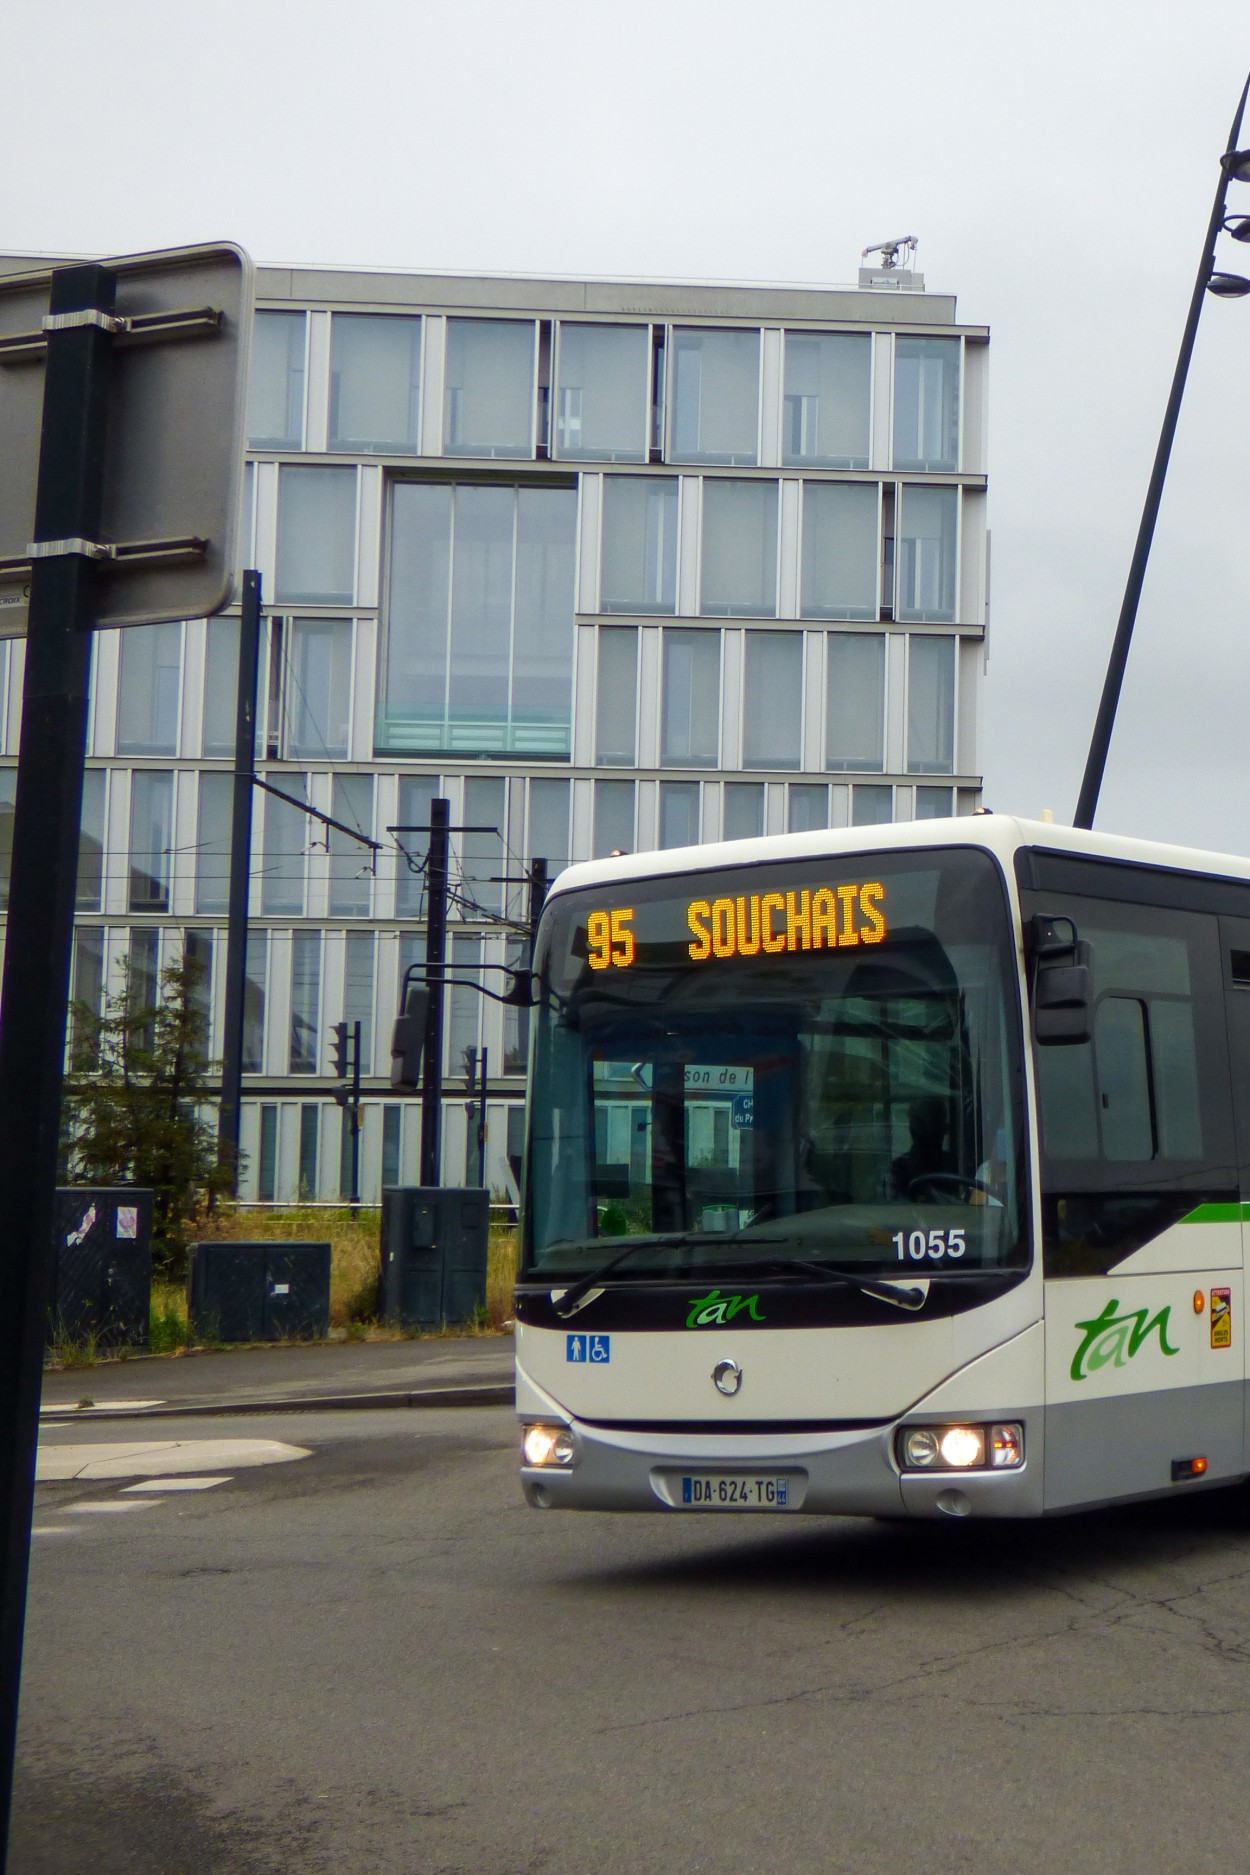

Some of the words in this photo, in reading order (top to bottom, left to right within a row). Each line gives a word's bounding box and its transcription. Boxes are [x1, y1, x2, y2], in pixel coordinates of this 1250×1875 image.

[587, 909, 635, 970] 95
[687, 882, 886, 960] SOUCHAIS
[719, 1068, 737, 1085] de
[892, 1229, 966, 1261] 1055
[685, 1290, 767, 1328] tan
[1070, 1299, 1180, 1381] tan
[693, 1480, 775, 1503] DA-624-TG
